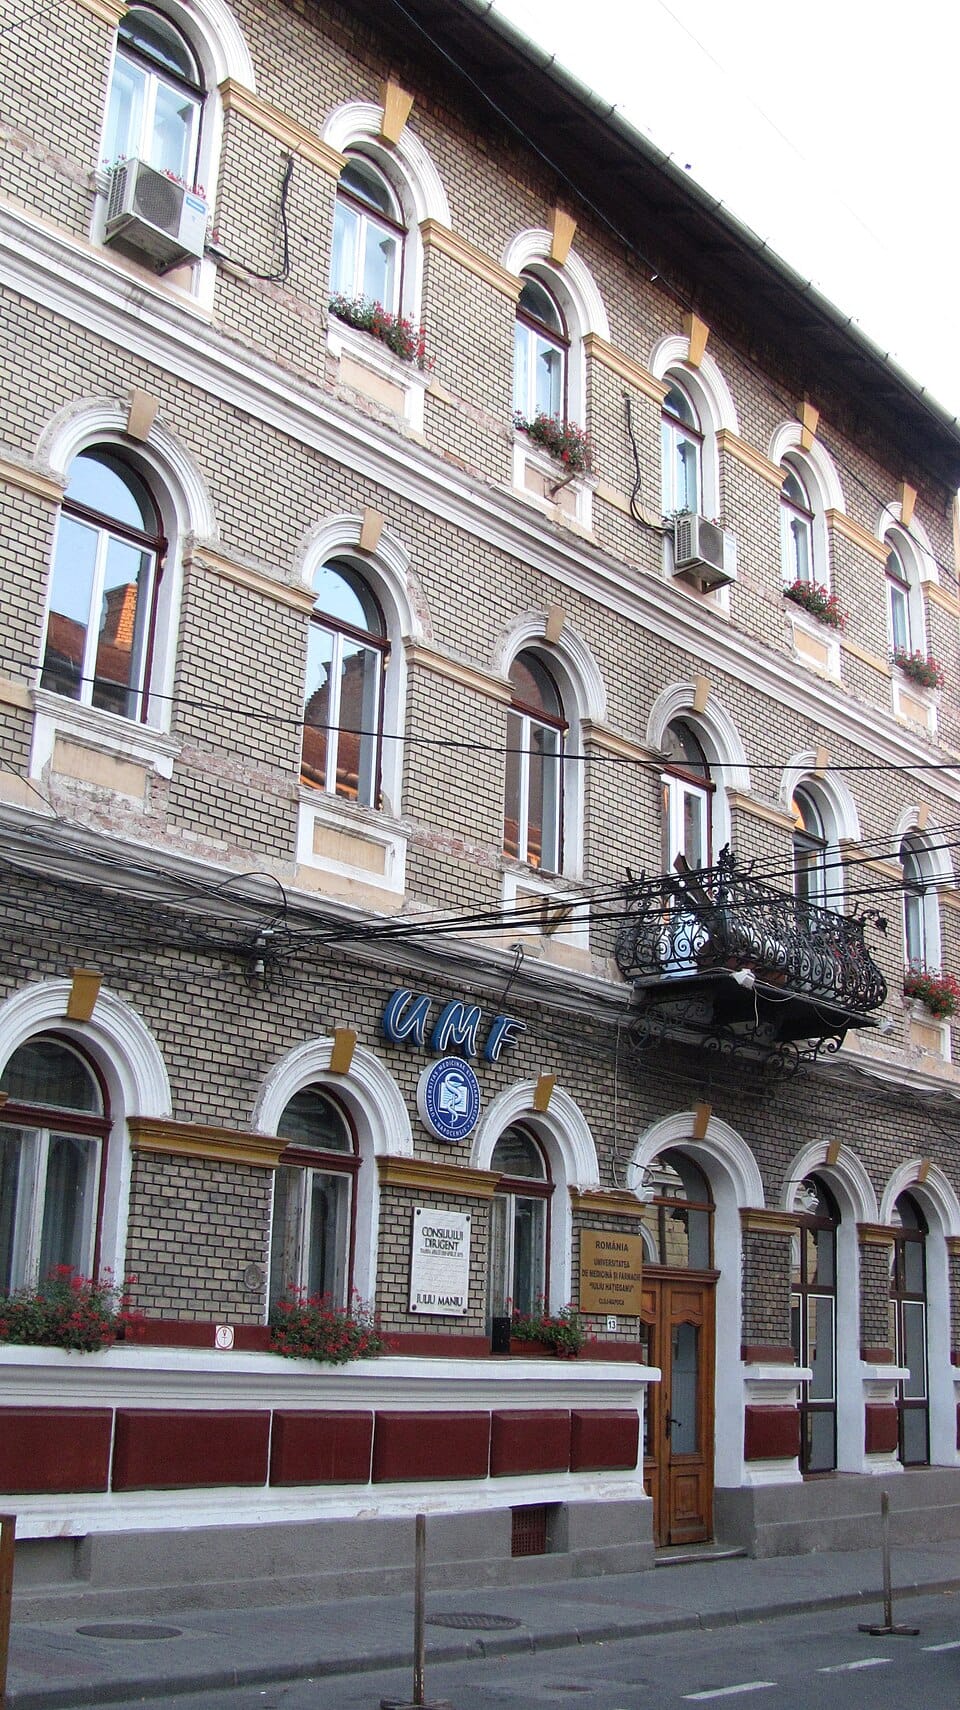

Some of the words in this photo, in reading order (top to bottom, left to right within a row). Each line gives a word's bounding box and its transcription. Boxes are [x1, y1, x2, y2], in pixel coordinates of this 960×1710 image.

[383, 988, 527, 1063] UMF
[425, 1238, 459, 1251] DIRIGENT
[595, 1240, 629, 1252] ROMÂNIA
[594, 1258, 630, 1268] UNIVERSITATEA
[582, 1269, 589, 1277] DE
[618, 1272, 641, 1282] FARMACIE
[416, 1293, 436, 1305] IULIU
[438, 1296, 463, 1307] MANIU
[608, 1320, 616, 1330] 13
